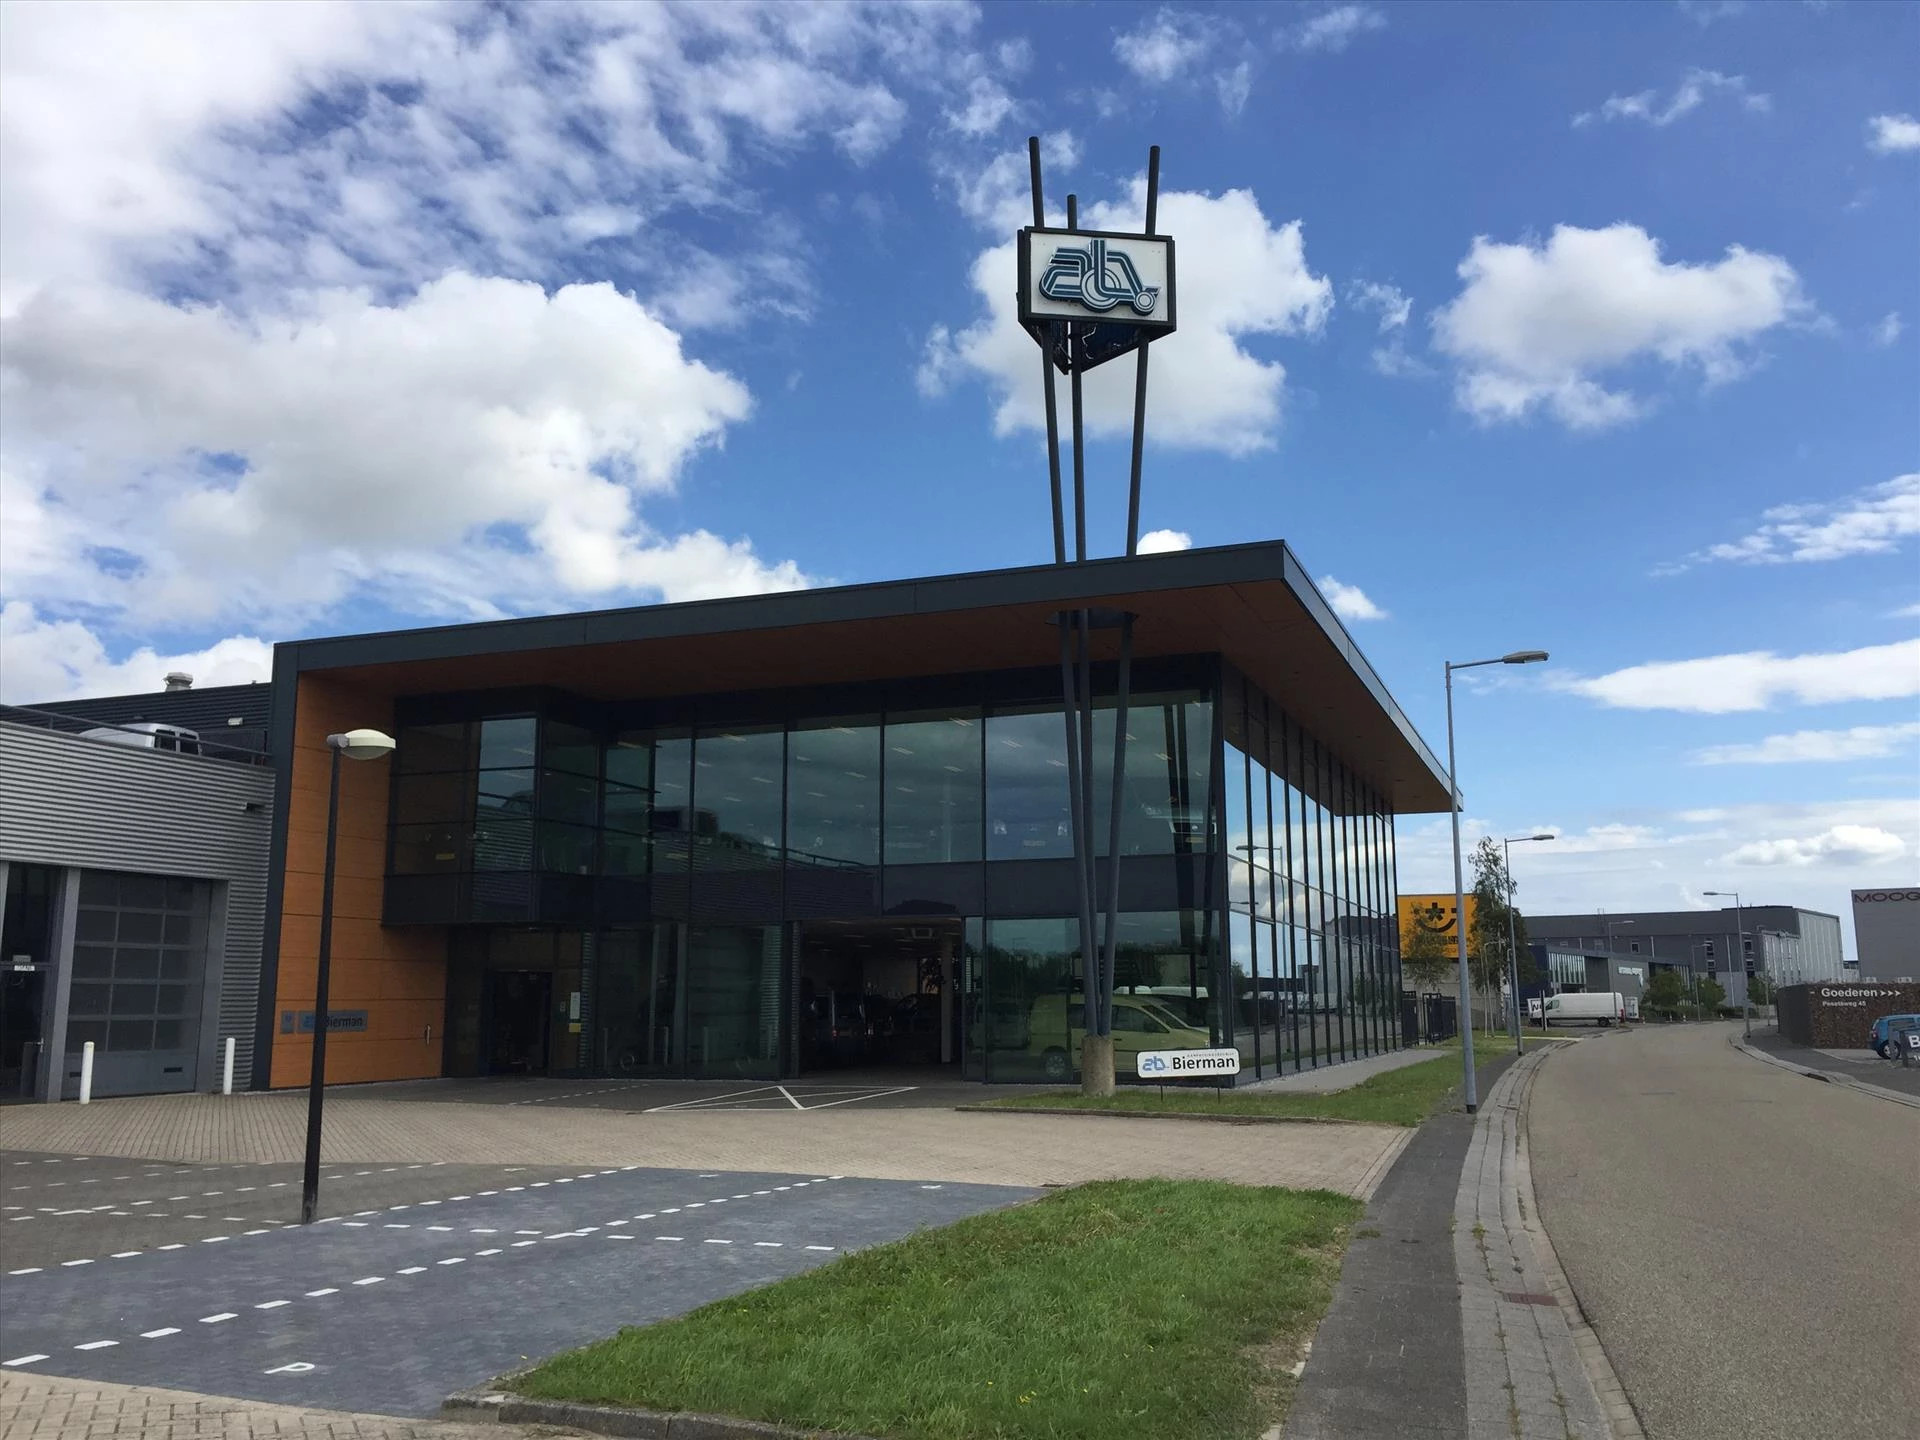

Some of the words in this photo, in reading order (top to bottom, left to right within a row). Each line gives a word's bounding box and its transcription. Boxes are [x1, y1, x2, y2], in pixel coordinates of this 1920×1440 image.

[1854, 891, 1920, 903] MOOG
[1821, 987, 1878, 997] Goederen
[1172, 1056, 1235, 1070] Bierman
[264, 1361, 315, 1375] P
